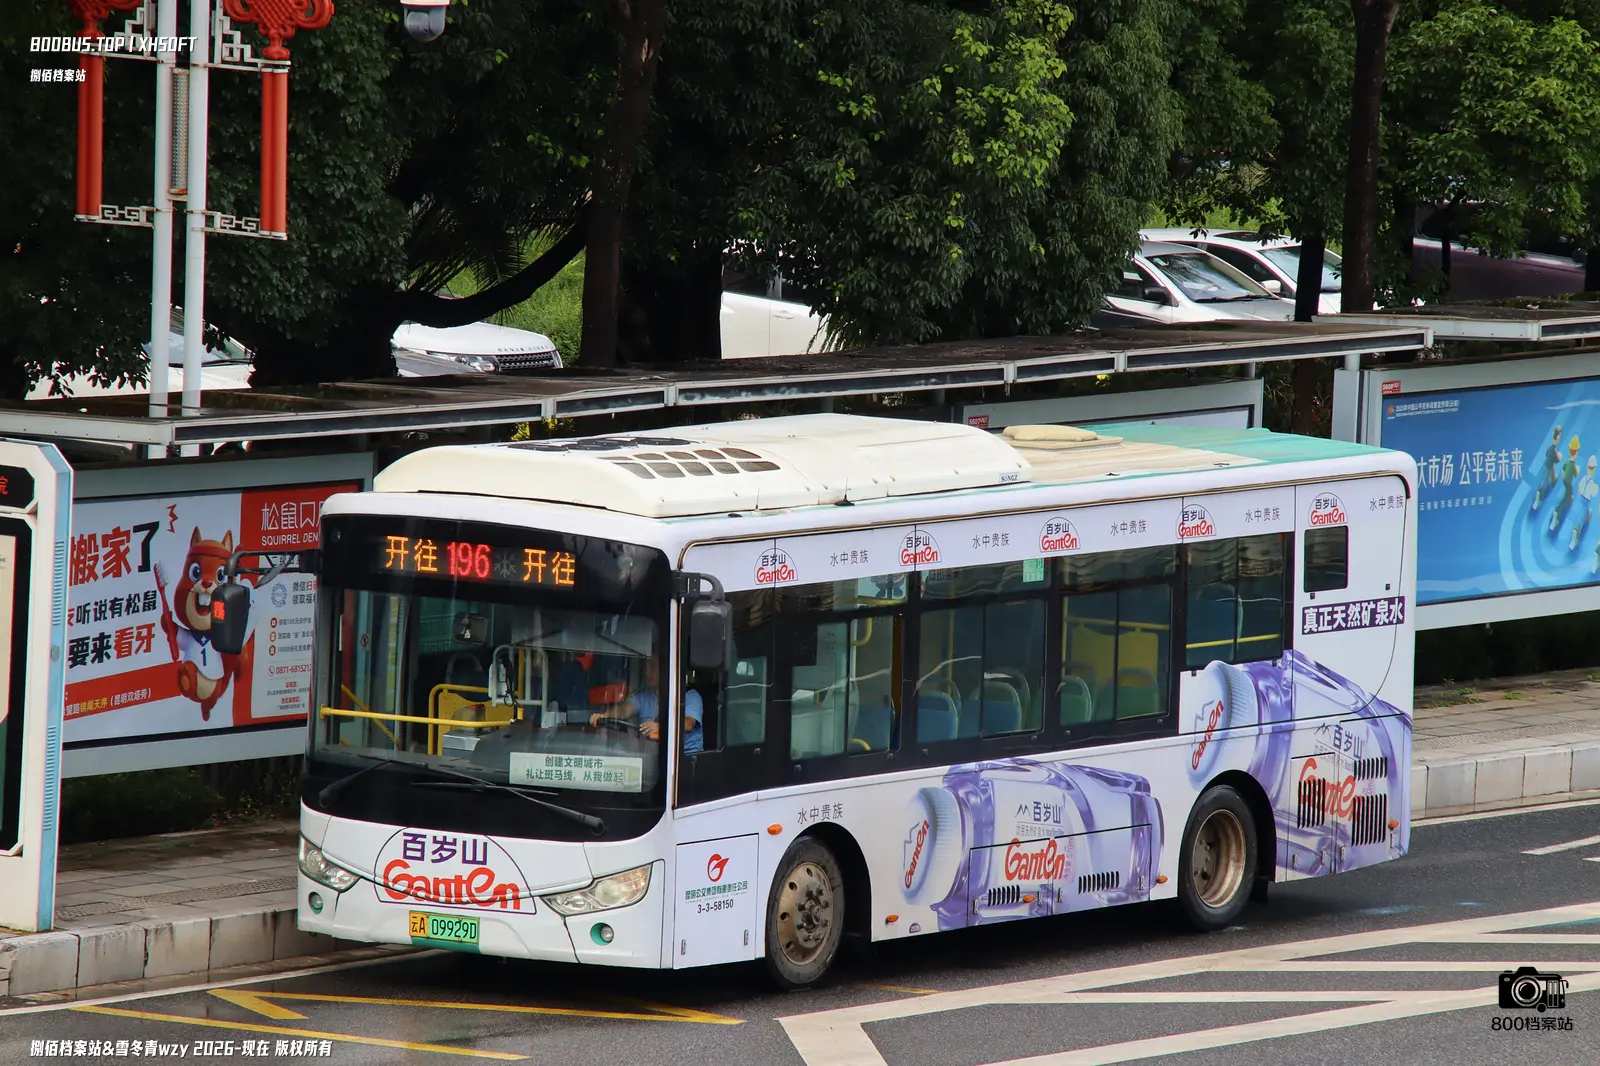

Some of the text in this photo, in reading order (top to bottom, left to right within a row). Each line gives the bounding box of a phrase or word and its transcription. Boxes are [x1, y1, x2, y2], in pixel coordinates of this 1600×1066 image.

[1417, 448, 1524, 489] 大市场 公平竞未来
[1315, 498, 1338, 510] 百岁山
[1370, 495, 1404, 511] 水中贵族
[1183, 509, 1205, 522] 百岁山
[1245, 507, 1280, 523] 水中贵族
[1311, 508, 1345, 525] Ganten
[1046, 522, 1069, 535] 百岁山
[1111, 519, 1147, 536] 水中贵族
[1178, 520, 1213, 537] Ganten
[261, 532, 319, 546] SQUIRREL DEN
[906, 535, 930, 549] 百岁山
[972, 532, 1010, 550] 水中贵族
[1041, 533, 1078, 551] Ganten
[69, 521, 160, 587] 搬家了
[385, 535, 575, 585] 开往 196 开往
[762, 554, 786, 567] 百岁山
[830, 549, 869, 567] 水中贵族
[901, 546, 939, 565] Ganten
[756, 564, 795, 583] Ganten
[1303, 598, 1404, 634] 真正天然矿泉水
[68, 623, 155, 669] 要来看牙
[201, 648, 207, 666] 1
[1333, 724, 1363, 760] 百岁山
[544, 756, 603, 769] 创建文明城市
[797, 803, 843, 825] 水中贵族
[1033, 801, 1061, 824] 百岁山
[402, 832, 488, 866] 百岁山
[1004, 837, 1066, 881] Ganten
[383, 859, 521, 910] Ganten
[697, 899, 734, 914] 3-3-58150
